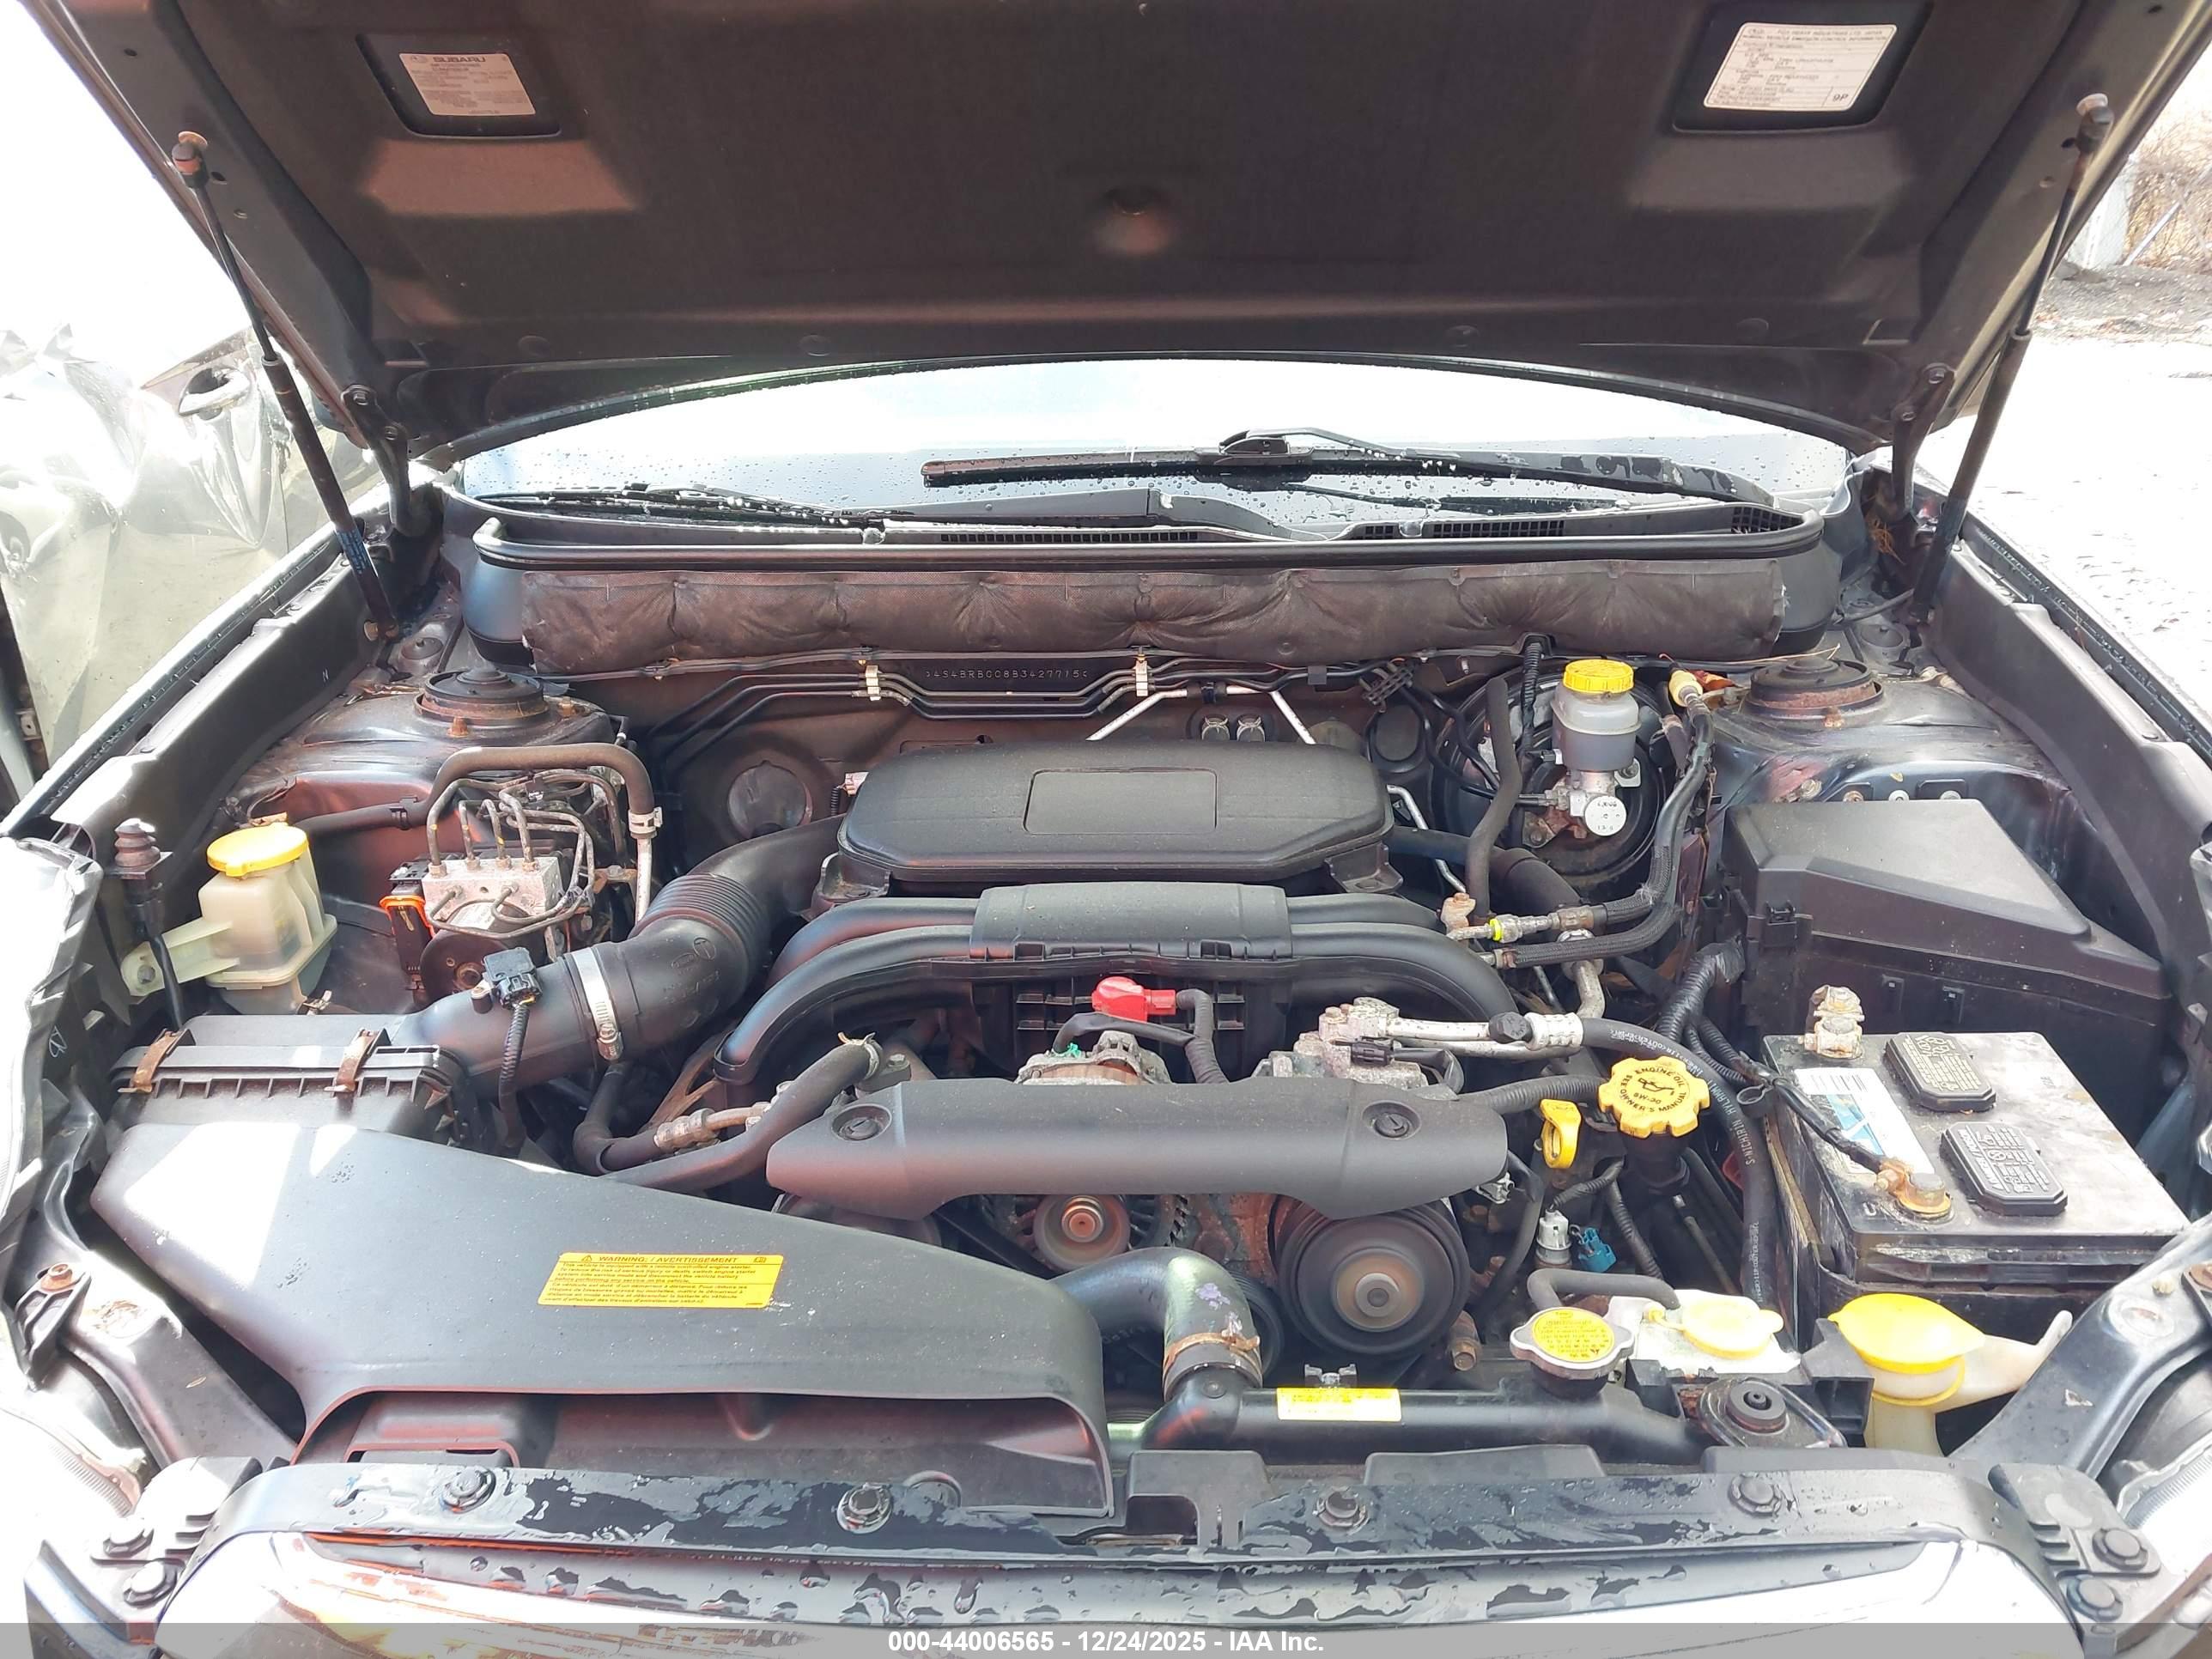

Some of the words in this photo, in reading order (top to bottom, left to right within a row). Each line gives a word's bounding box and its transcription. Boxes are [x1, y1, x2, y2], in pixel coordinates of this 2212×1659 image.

[1634, 1066, 1675, 1077] ENGINE
[1673, 1076, 1686, 1088] OIL
[1620, 1074, 1633, 1087] SEE
[1658, 1091, 1687, 1113] MANUAL
